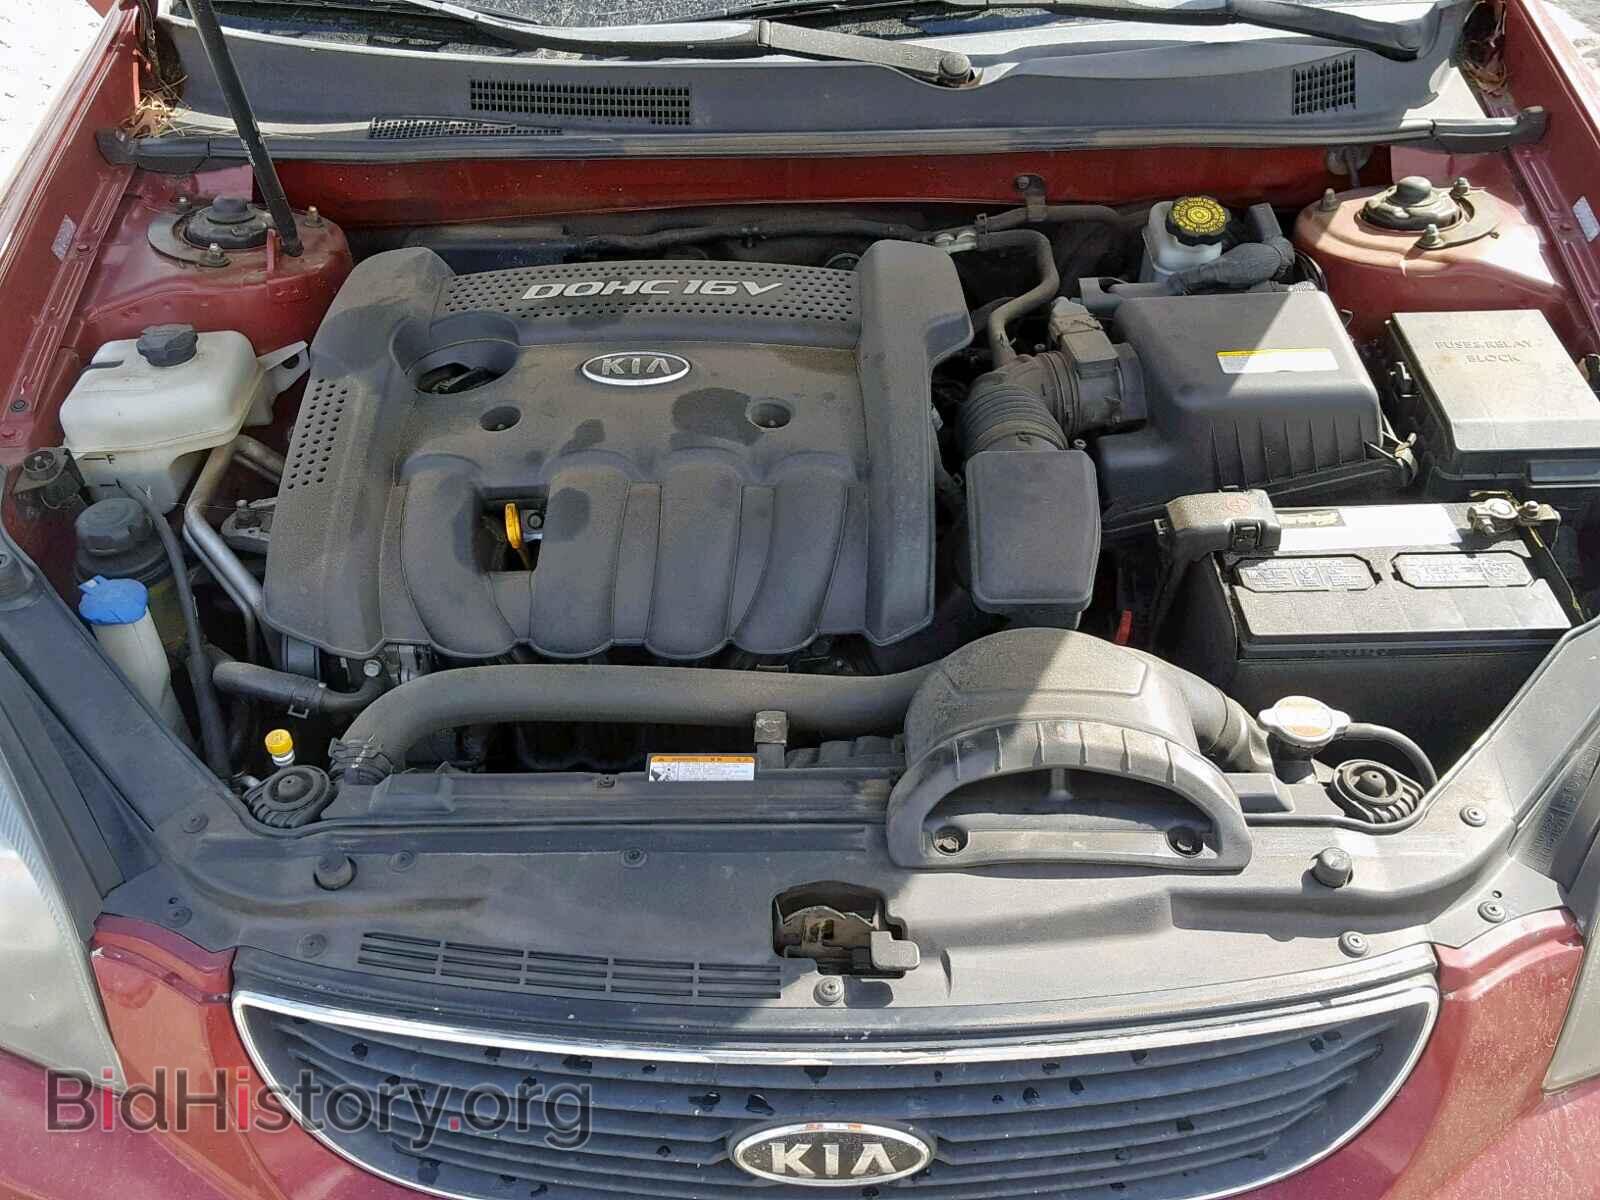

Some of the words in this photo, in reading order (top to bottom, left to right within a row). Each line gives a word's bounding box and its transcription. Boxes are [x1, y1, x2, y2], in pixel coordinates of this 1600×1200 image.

[521, 280, 679, 299] DOHC
[683, 280, 783, 296] 16V
[600, 357, 672, 376] KIA
[1466, 354, 1521, 363] BLOCK
[768, 1142, 897, 1177] KIA
